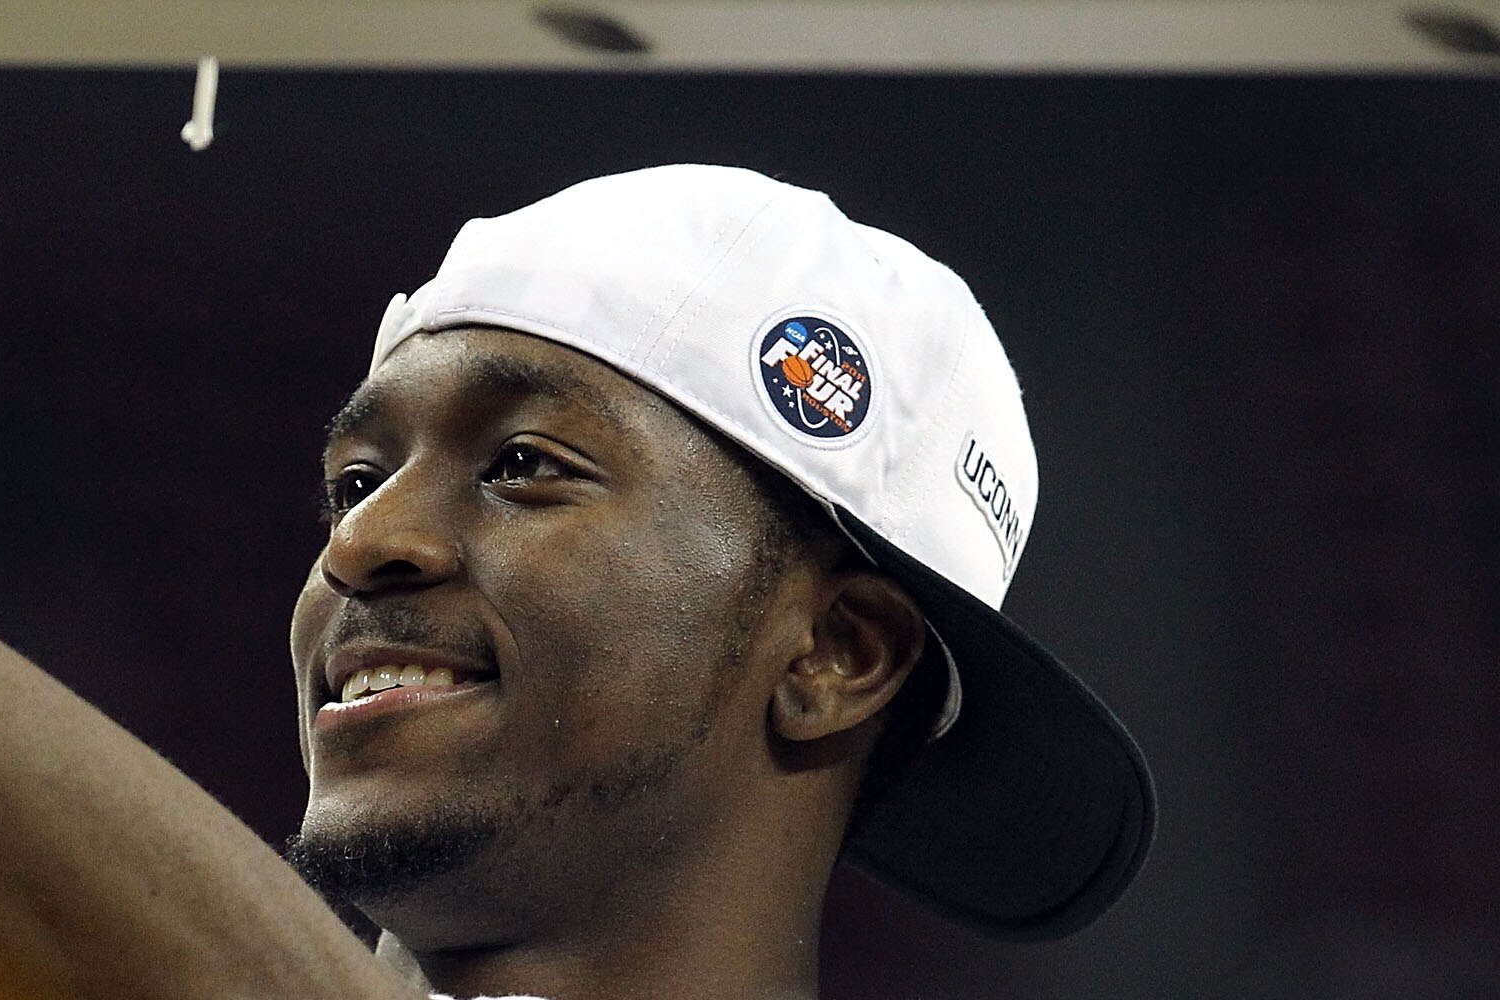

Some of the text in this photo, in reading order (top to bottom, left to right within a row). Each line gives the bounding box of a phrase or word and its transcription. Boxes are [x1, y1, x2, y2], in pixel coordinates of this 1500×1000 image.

[785, 327, 806, 343] NCAA
[798, 339, 863, 400] FINAL
[802, 392, 851, 433] HOUSTON
[963, 438, 1024, 573] UCONN
